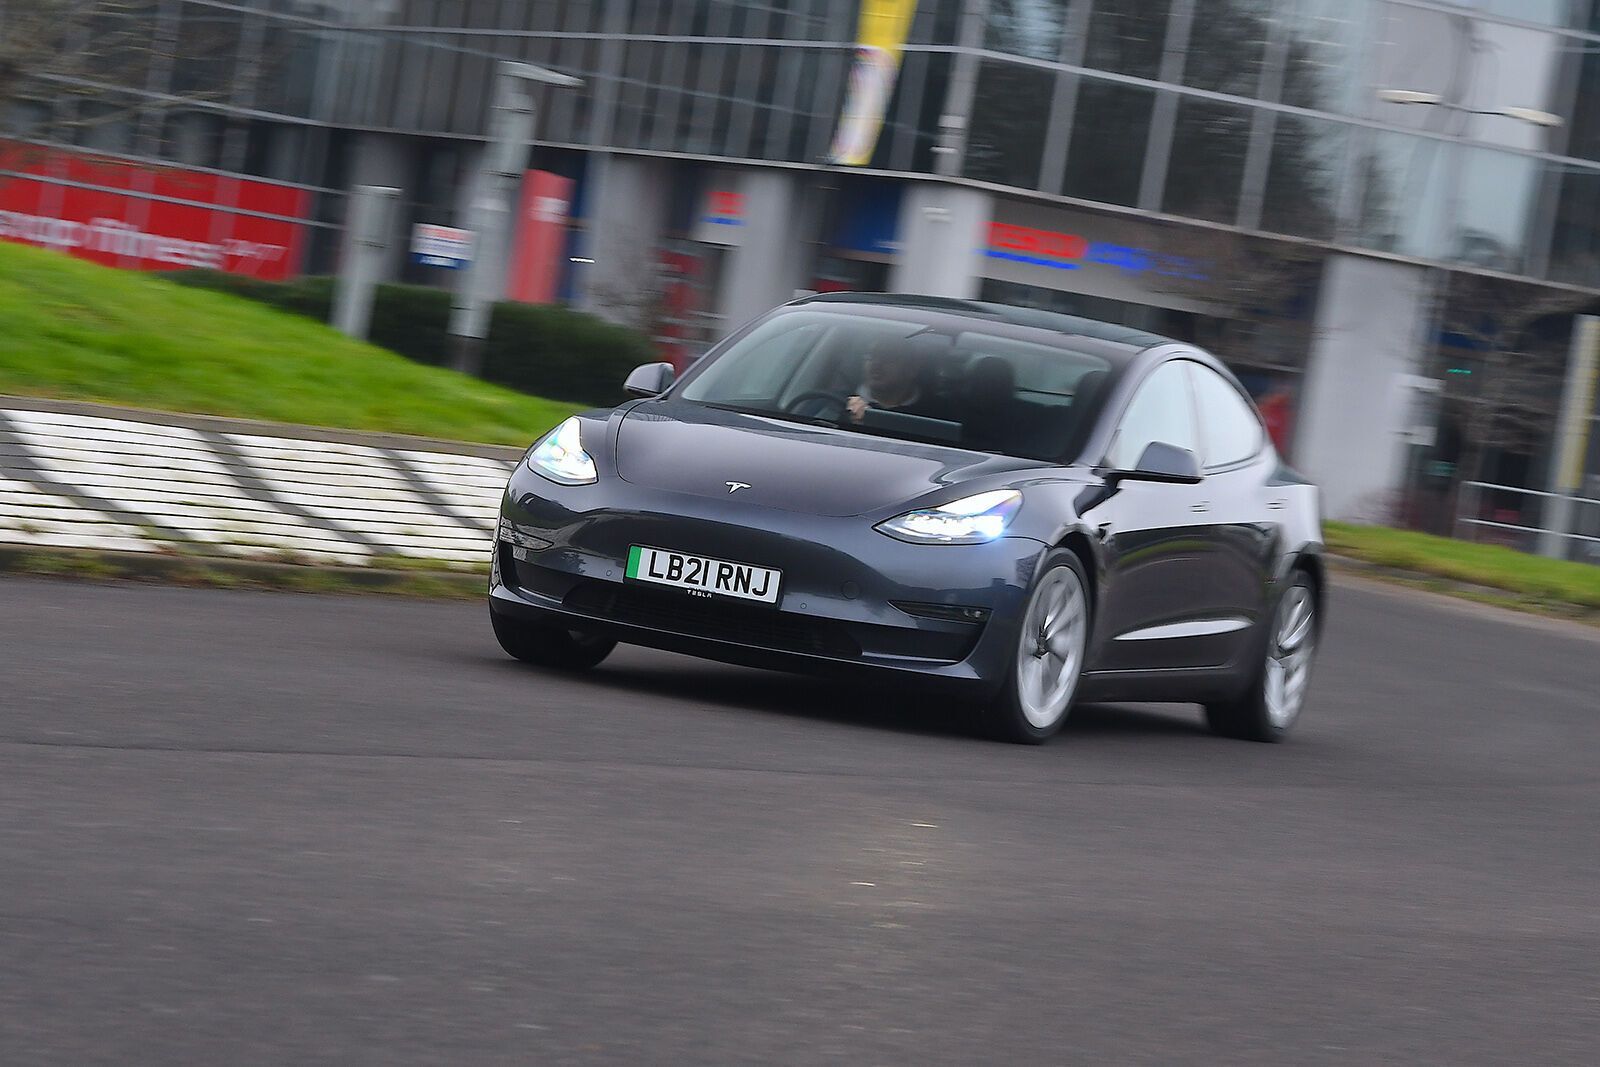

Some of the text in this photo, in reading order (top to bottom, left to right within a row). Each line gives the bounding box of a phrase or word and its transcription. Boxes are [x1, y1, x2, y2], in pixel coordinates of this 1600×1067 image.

[648, 550, 771, 597] LB21 RNJ
[686, 589, 712, 599] TESLA
